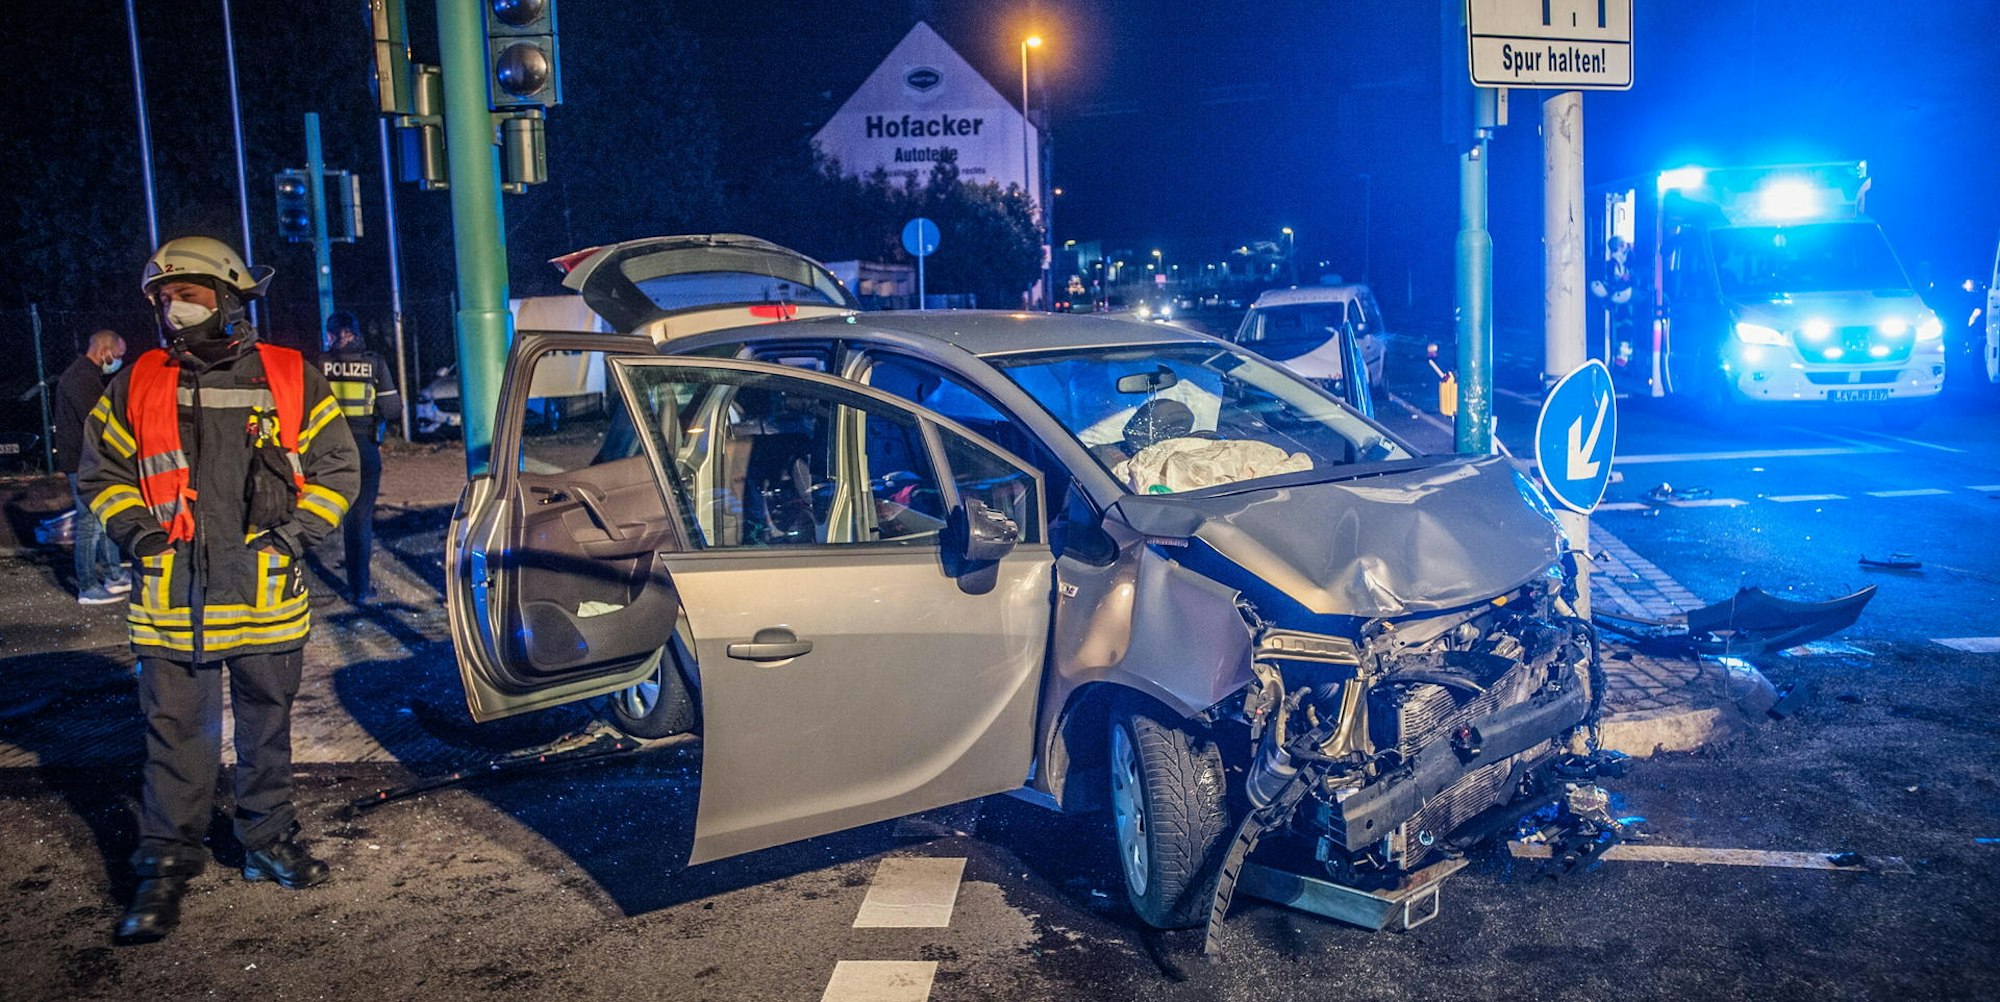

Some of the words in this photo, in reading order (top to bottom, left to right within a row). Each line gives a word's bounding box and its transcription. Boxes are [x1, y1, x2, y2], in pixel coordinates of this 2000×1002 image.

[1503, 44, 1542, 77] Spur
[1548, 46, 1605, 73] halten!
[866, 114, 983, 138] Hofacker
[324, 361, 373, 378] POLIZEI
